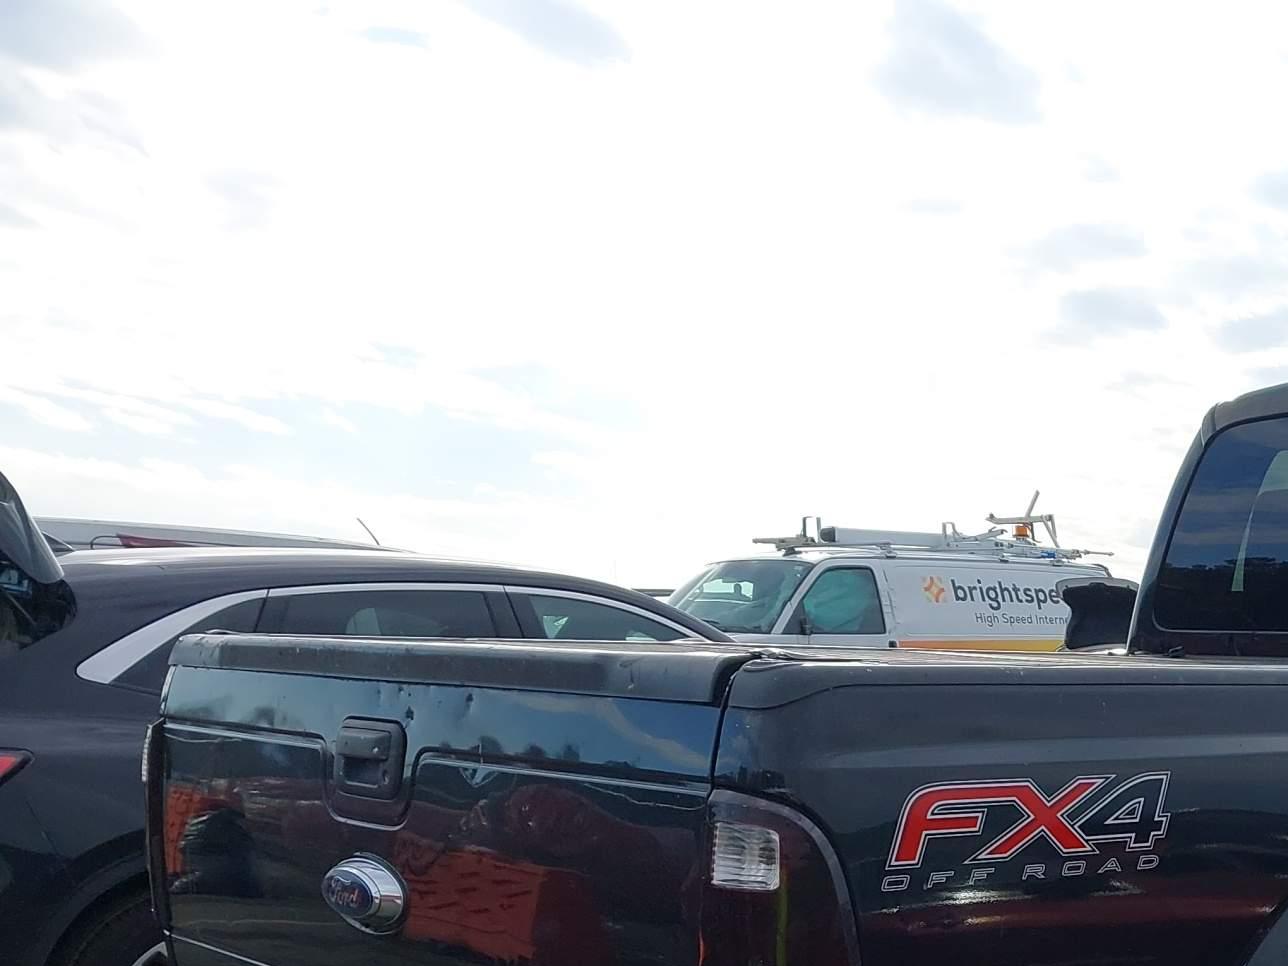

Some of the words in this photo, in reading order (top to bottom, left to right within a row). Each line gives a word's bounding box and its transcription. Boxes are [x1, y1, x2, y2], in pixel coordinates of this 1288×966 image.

[975, 612, 1000, 627] High
[1002, 613, 1033, 626] Speed
[885, 770, 1171, 871] FX4
[881, 867, 995, 892] OFF
[1022, 854, 1160, 881] ROAD
[328, 875, 360, 908] Ford
